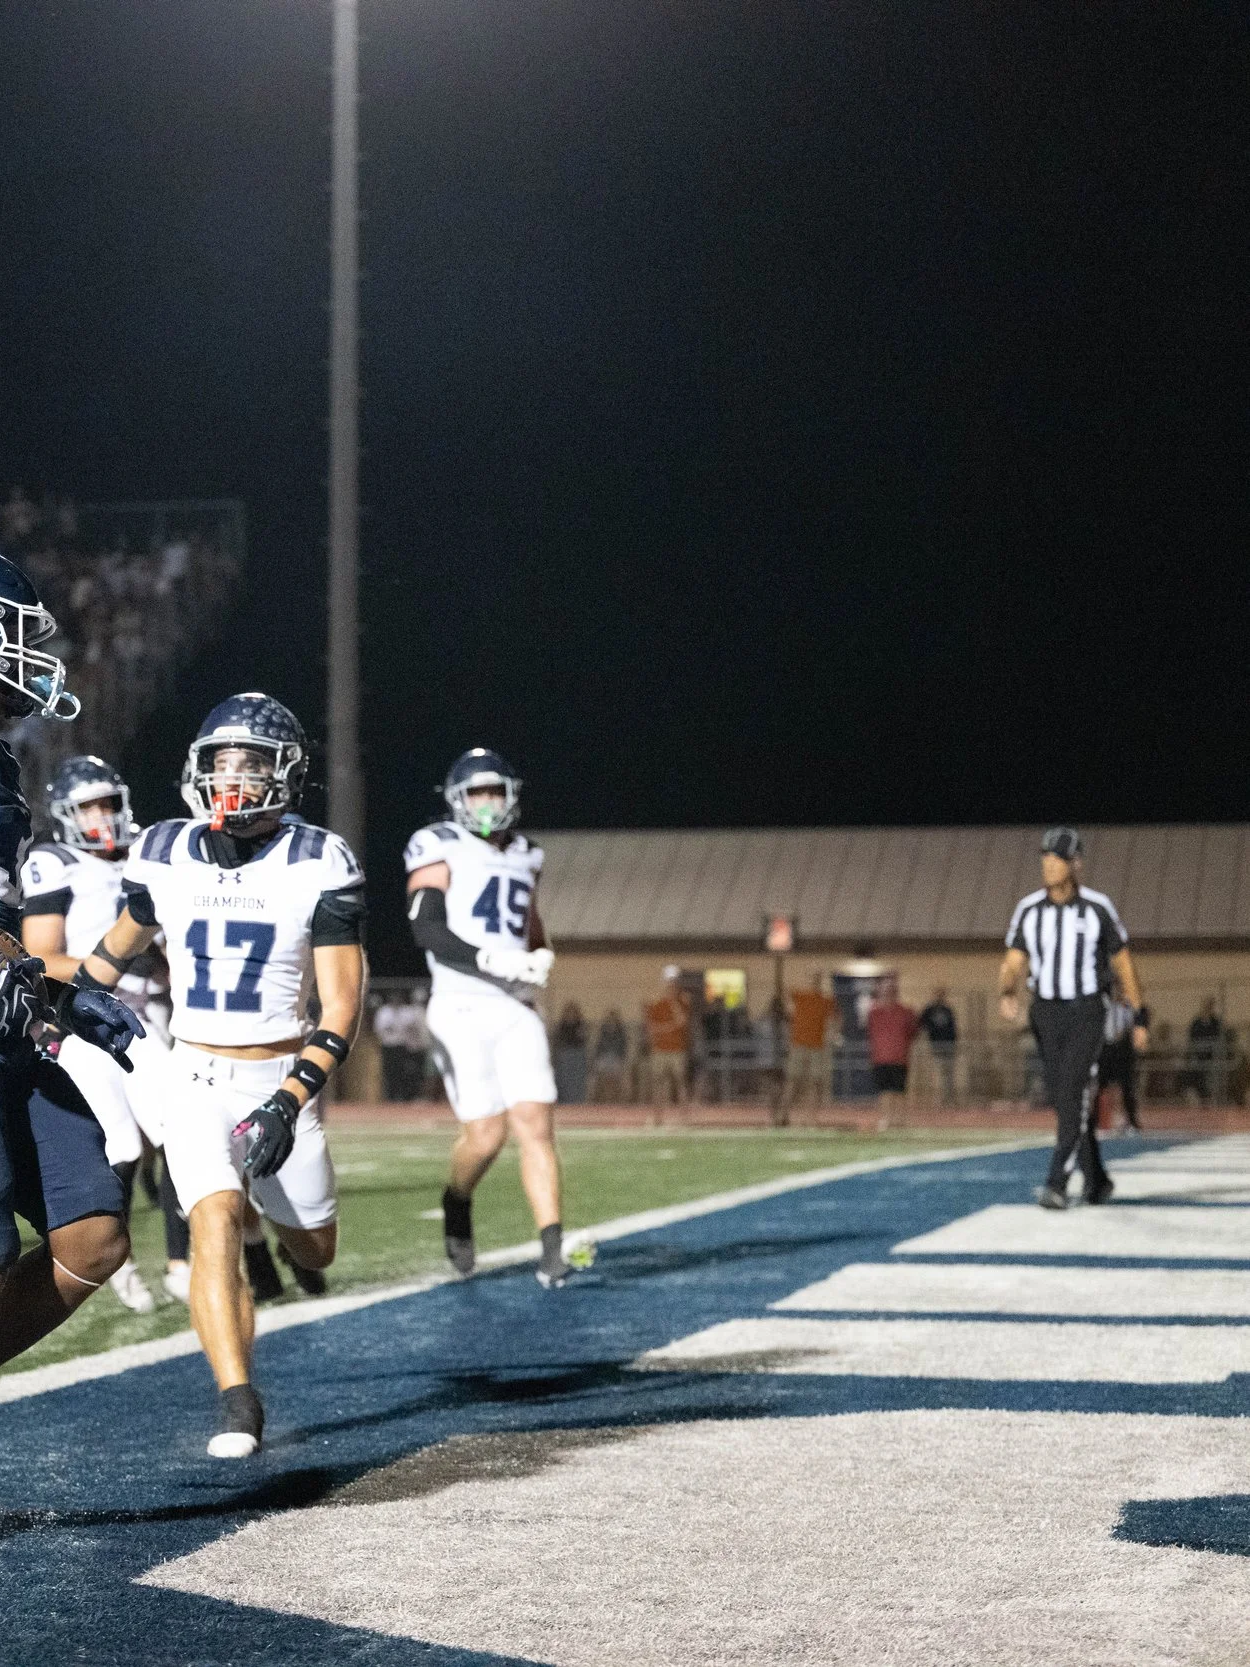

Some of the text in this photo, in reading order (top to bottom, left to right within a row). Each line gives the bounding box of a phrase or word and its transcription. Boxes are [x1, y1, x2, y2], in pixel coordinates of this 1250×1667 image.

[193, 896, 266, 910] CHAMPION
[471, 875, 530, 938] 45
[185, 918, 277, 1013] 17
